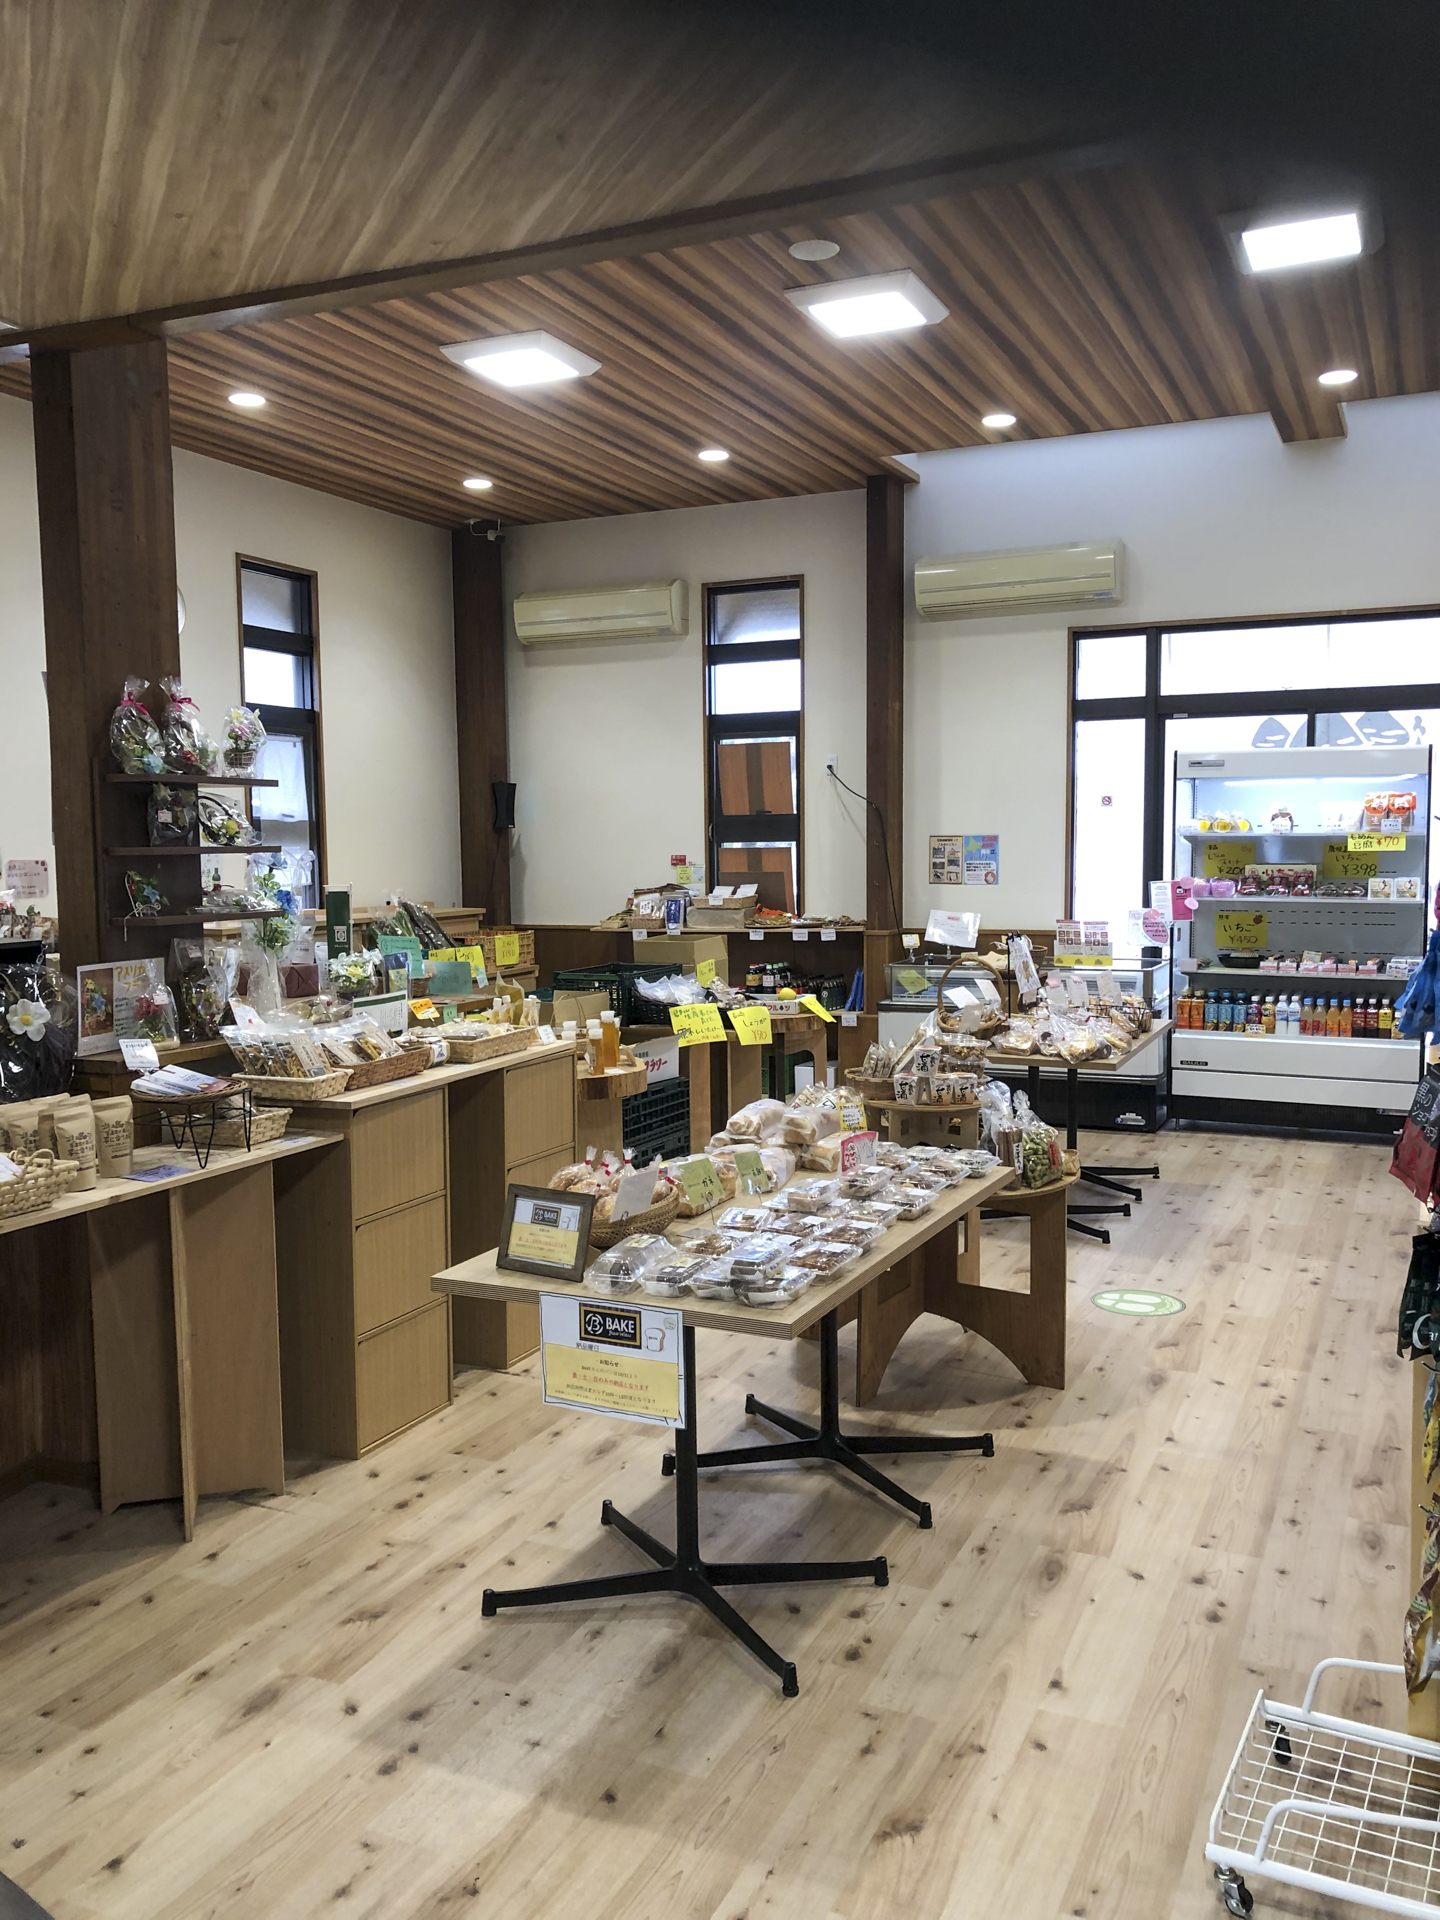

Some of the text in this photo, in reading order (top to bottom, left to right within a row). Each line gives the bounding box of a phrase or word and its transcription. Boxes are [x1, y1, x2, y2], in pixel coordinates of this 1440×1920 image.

[1377, 835, 1399, 848] ¥70
[1336, 853, 1367, 862] いちご
[1341, 863, 1377, 877] ¥398
[1223, 923, 1254, 932] いちご
[544, 1211, 558, 1219] BAKE
[605, 1317, 635, 1334] BAKE
[599, 1360, 619, 1368] お知らせ
